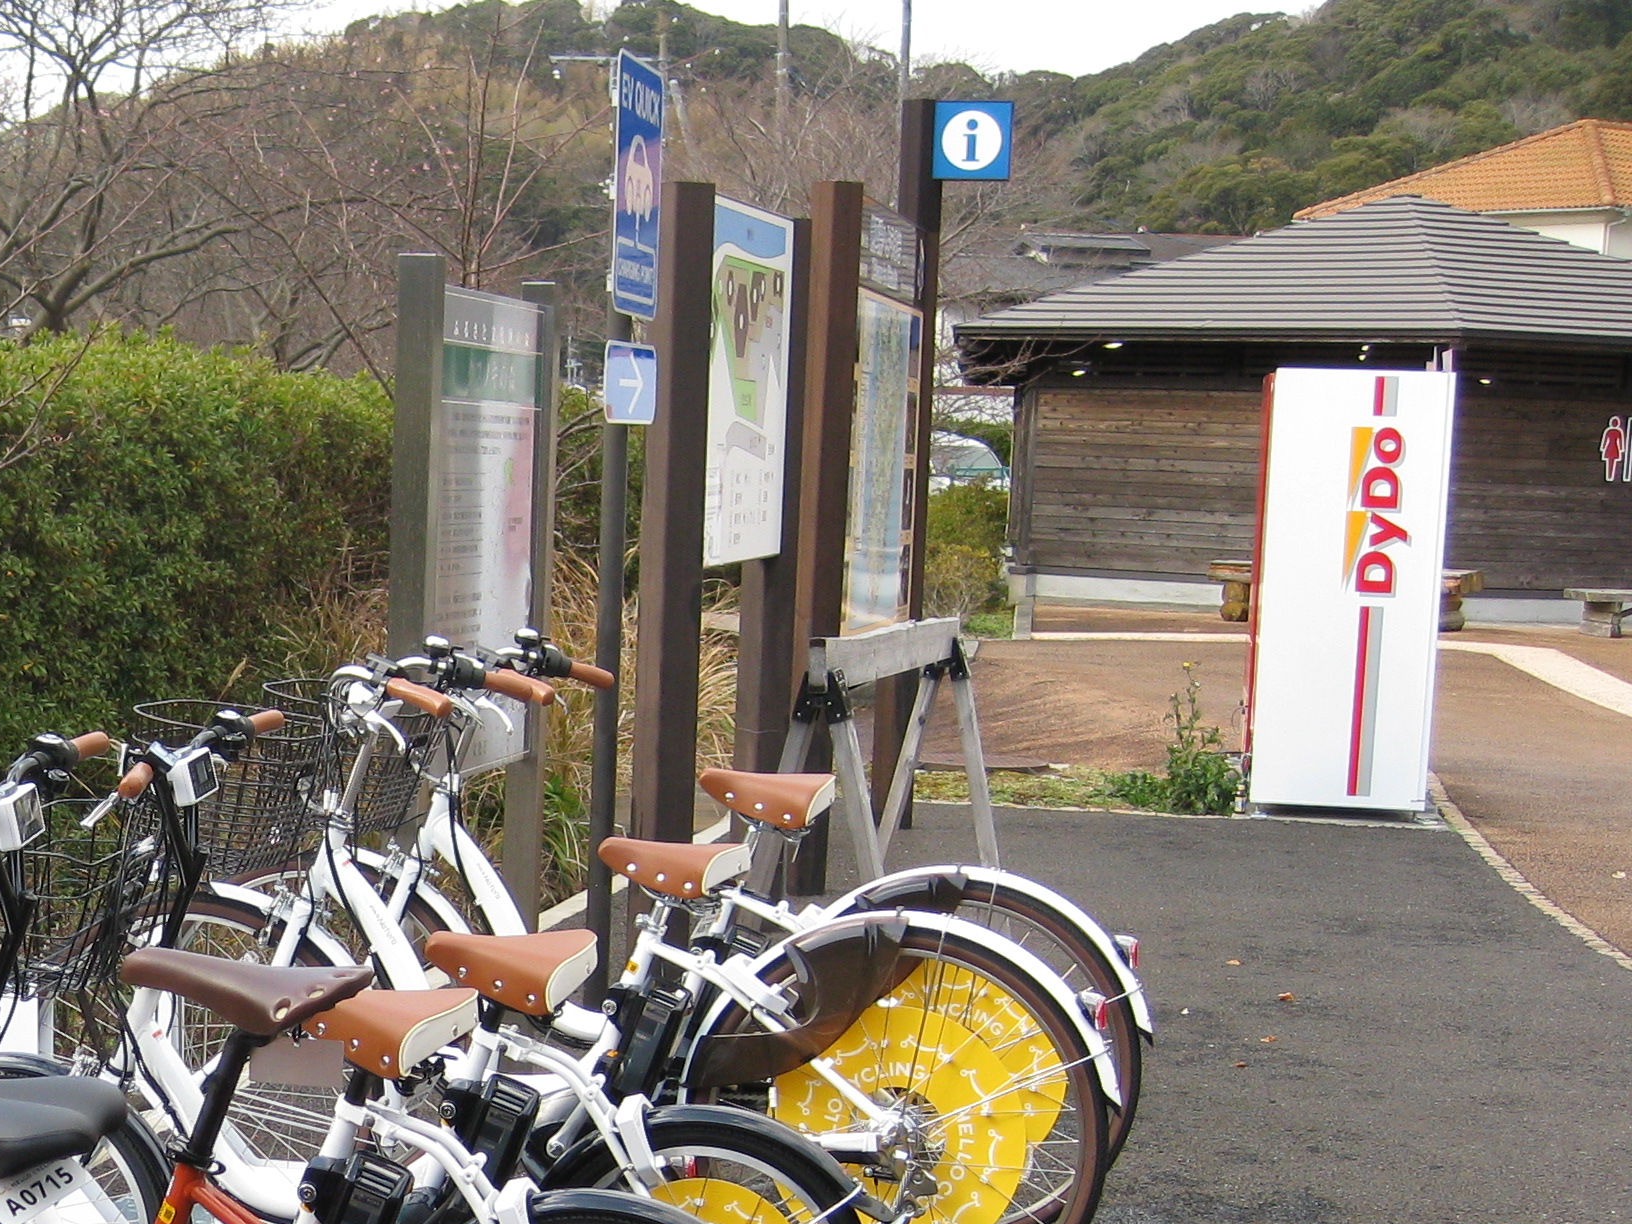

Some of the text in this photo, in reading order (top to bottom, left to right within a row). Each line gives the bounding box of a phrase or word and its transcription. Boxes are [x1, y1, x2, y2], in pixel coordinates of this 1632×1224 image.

[622, 71, 661, 128] EV QUICK
[1355, 427, 1410, 596] DyDo
[848, 1061, 928, 1089] YCLING
[6, 1166, 74, 1217] A0715
